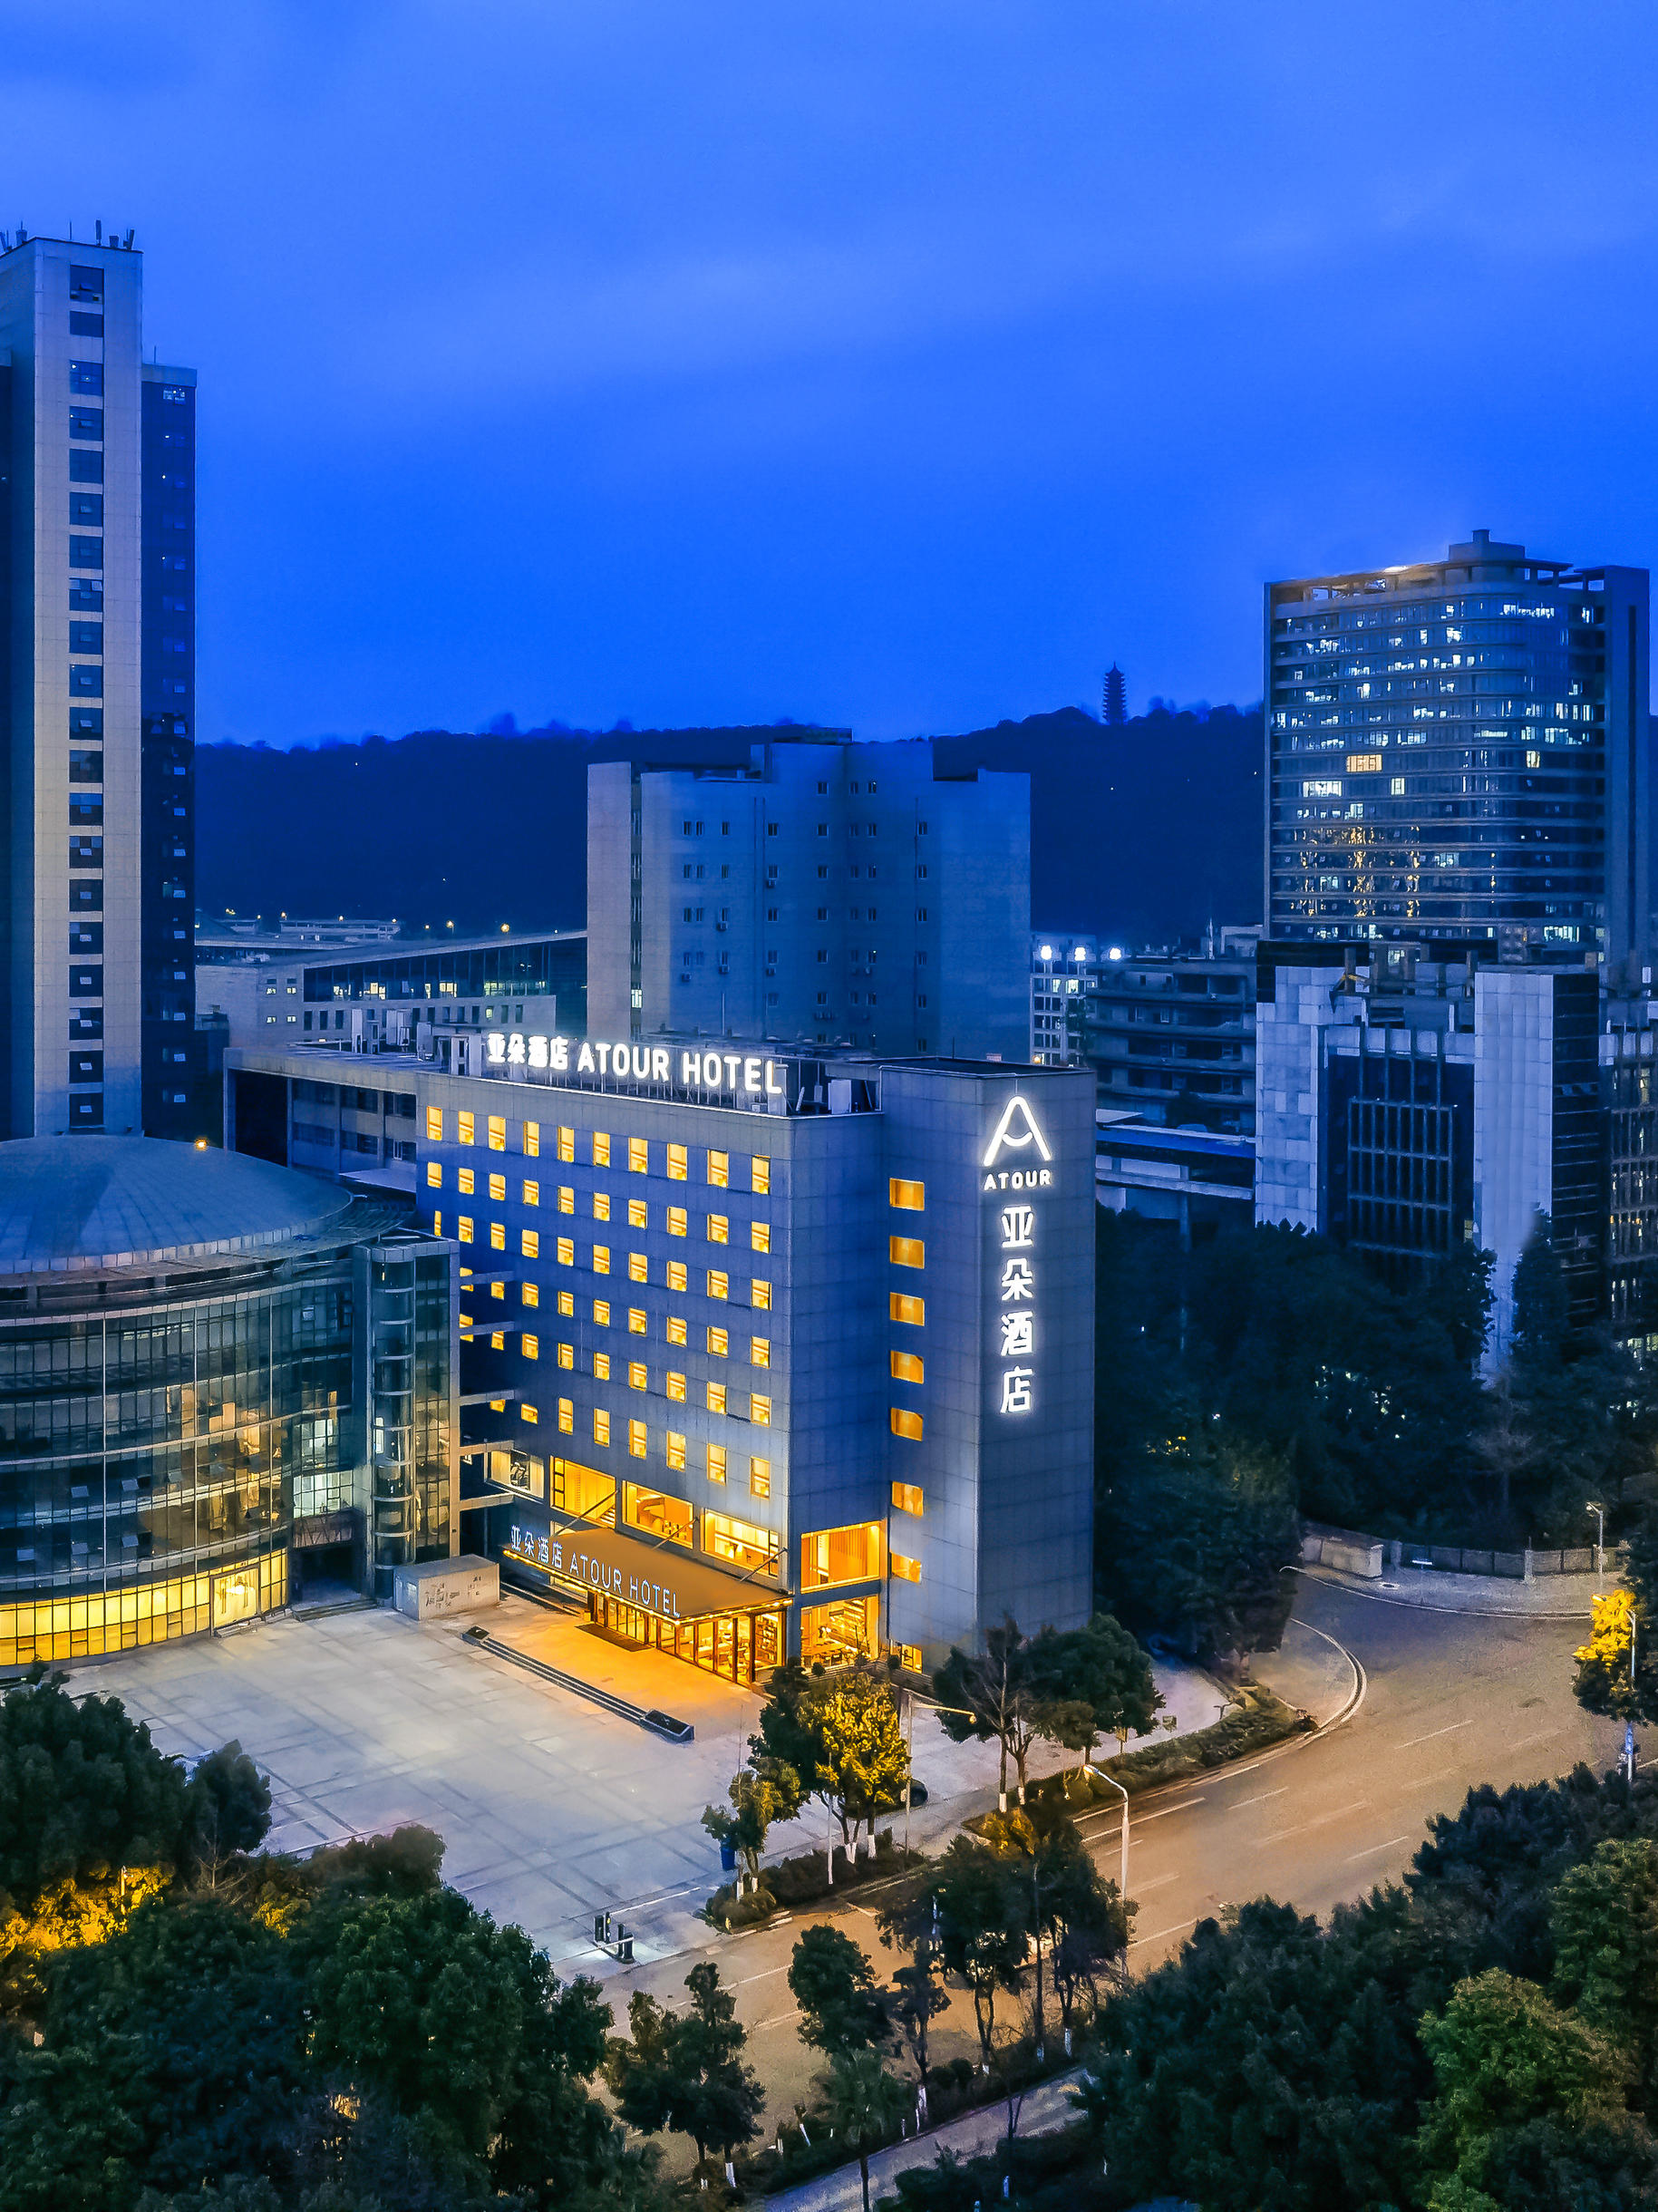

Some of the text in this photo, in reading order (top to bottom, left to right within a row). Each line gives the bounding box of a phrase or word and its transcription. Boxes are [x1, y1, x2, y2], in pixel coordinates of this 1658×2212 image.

[577, 1043, 669, 1081] ATOUR
[682, 1052, 782, 1094] HOTEL
[984, 1169, 1052, 1191] ATOUR
[1000, 1205, 1034, 1414] 亚朵酒店
[510, 1525, 682, 1619] 亚朵酒店 ATOUR HOTEL
